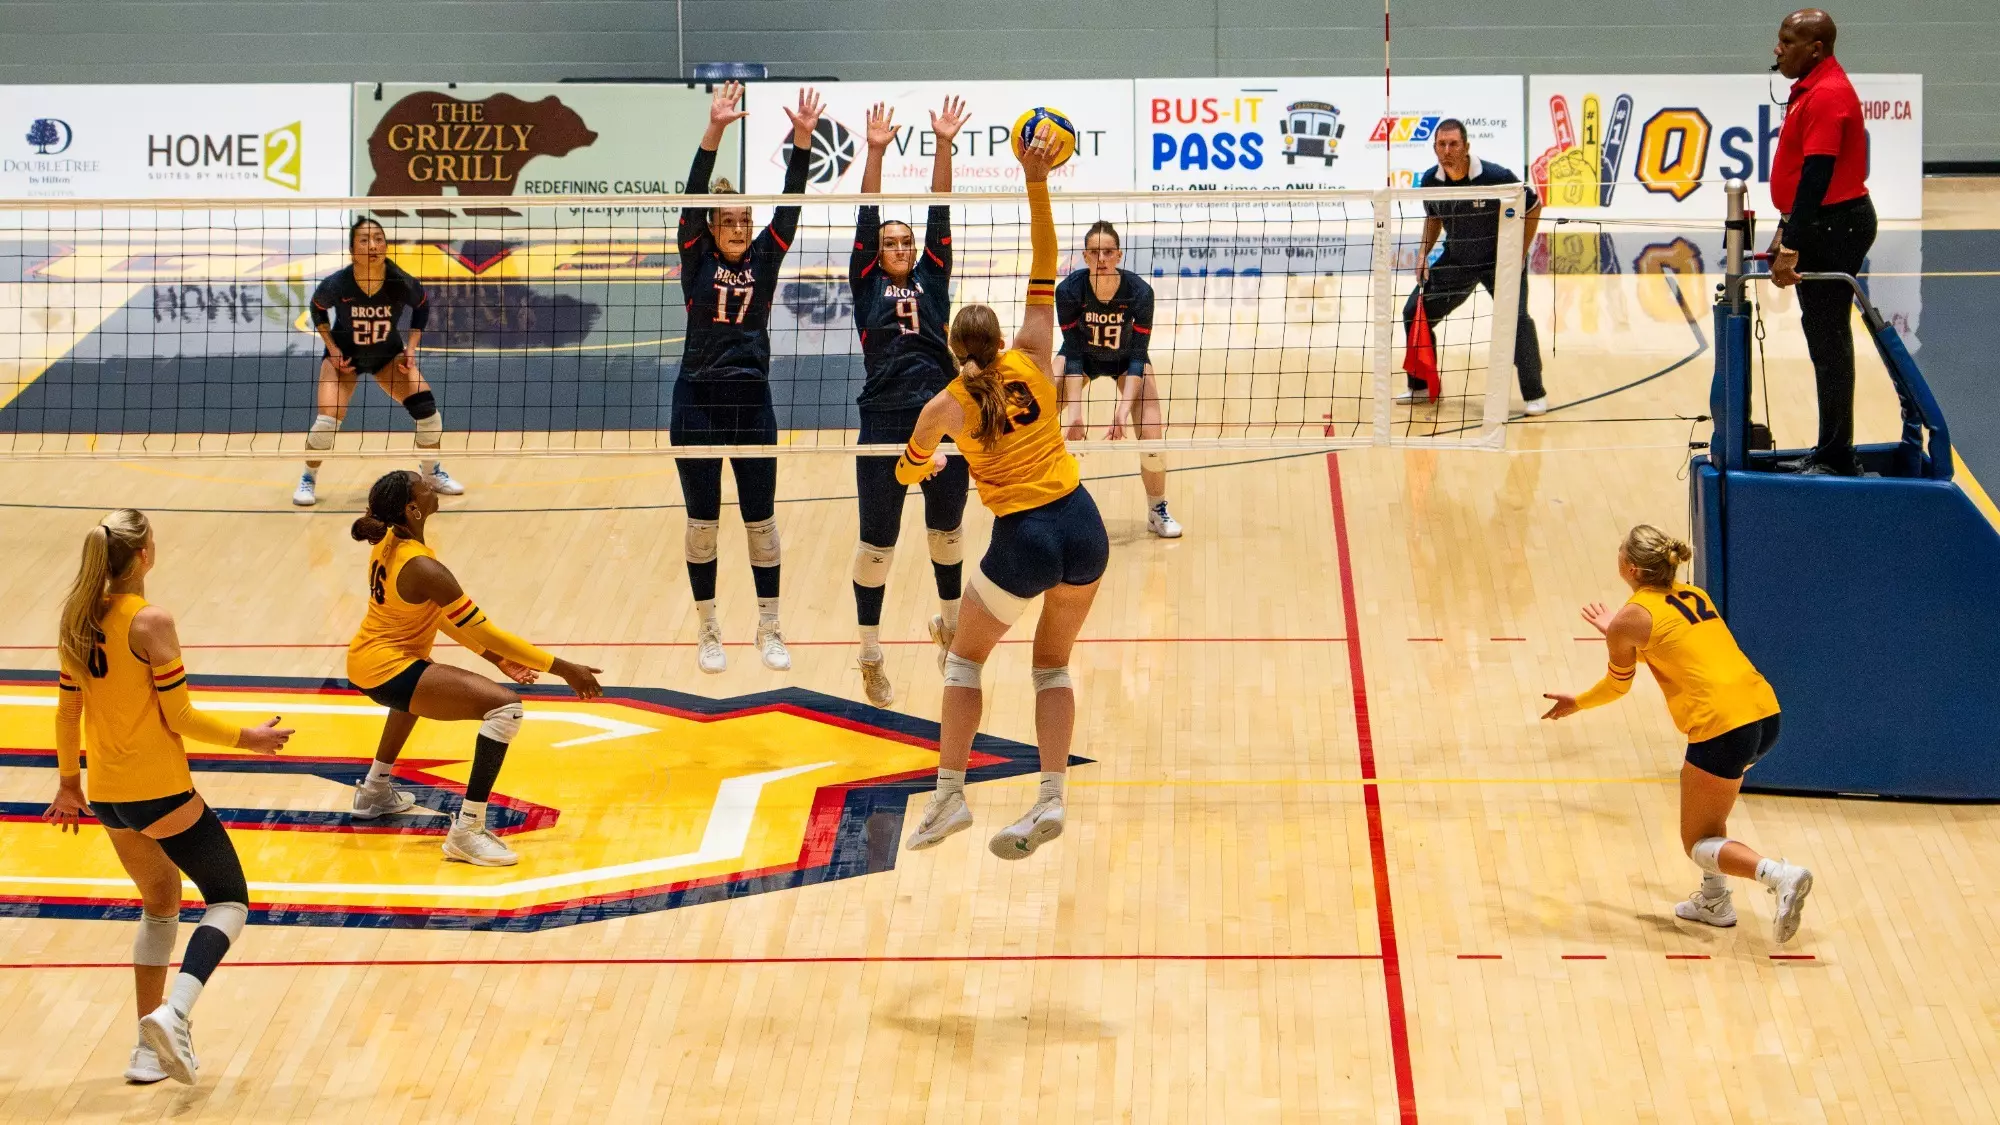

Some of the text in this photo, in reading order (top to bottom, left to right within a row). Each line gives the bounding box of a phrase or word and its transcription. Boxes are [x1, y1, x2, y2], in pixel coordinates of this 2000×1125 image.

[432, 103, 485, 123] THE
[1152, 98, 1263, 124] BUS-IT
[1861, 101, 1912, 120] HOP.CA
[387, 123, 534, 151] GRIZZLY
[1373, 117, 1432, 141] AMS
[148, 134, 259, 167] HOME
[1152, 132, 1263, 170] PASS
[148, 172, 259, 180] SUITES BY HILTON
[407, 154, 513, 182] GRILL
[954, 164, 999, 178] siness
[1004, 164, 1021, 179] of
[29, 176, 72, 185] by Hilton
[524, 181, 608, 194] REDEFINING
[614, 181, 670, 194] CASUAL
[714, 265, 755, 286] BROCK
[351, 305, 392, 318] BROCK
[712, 283, 754, 325] 17
[896, 297, 920, 335] 9
[1085, 311, 1125, 324] BROCK
[352, 320, 391, 345] 20
[1087, 324, 1122, 350] 19
[1665, 590, 1719, 625] 12
